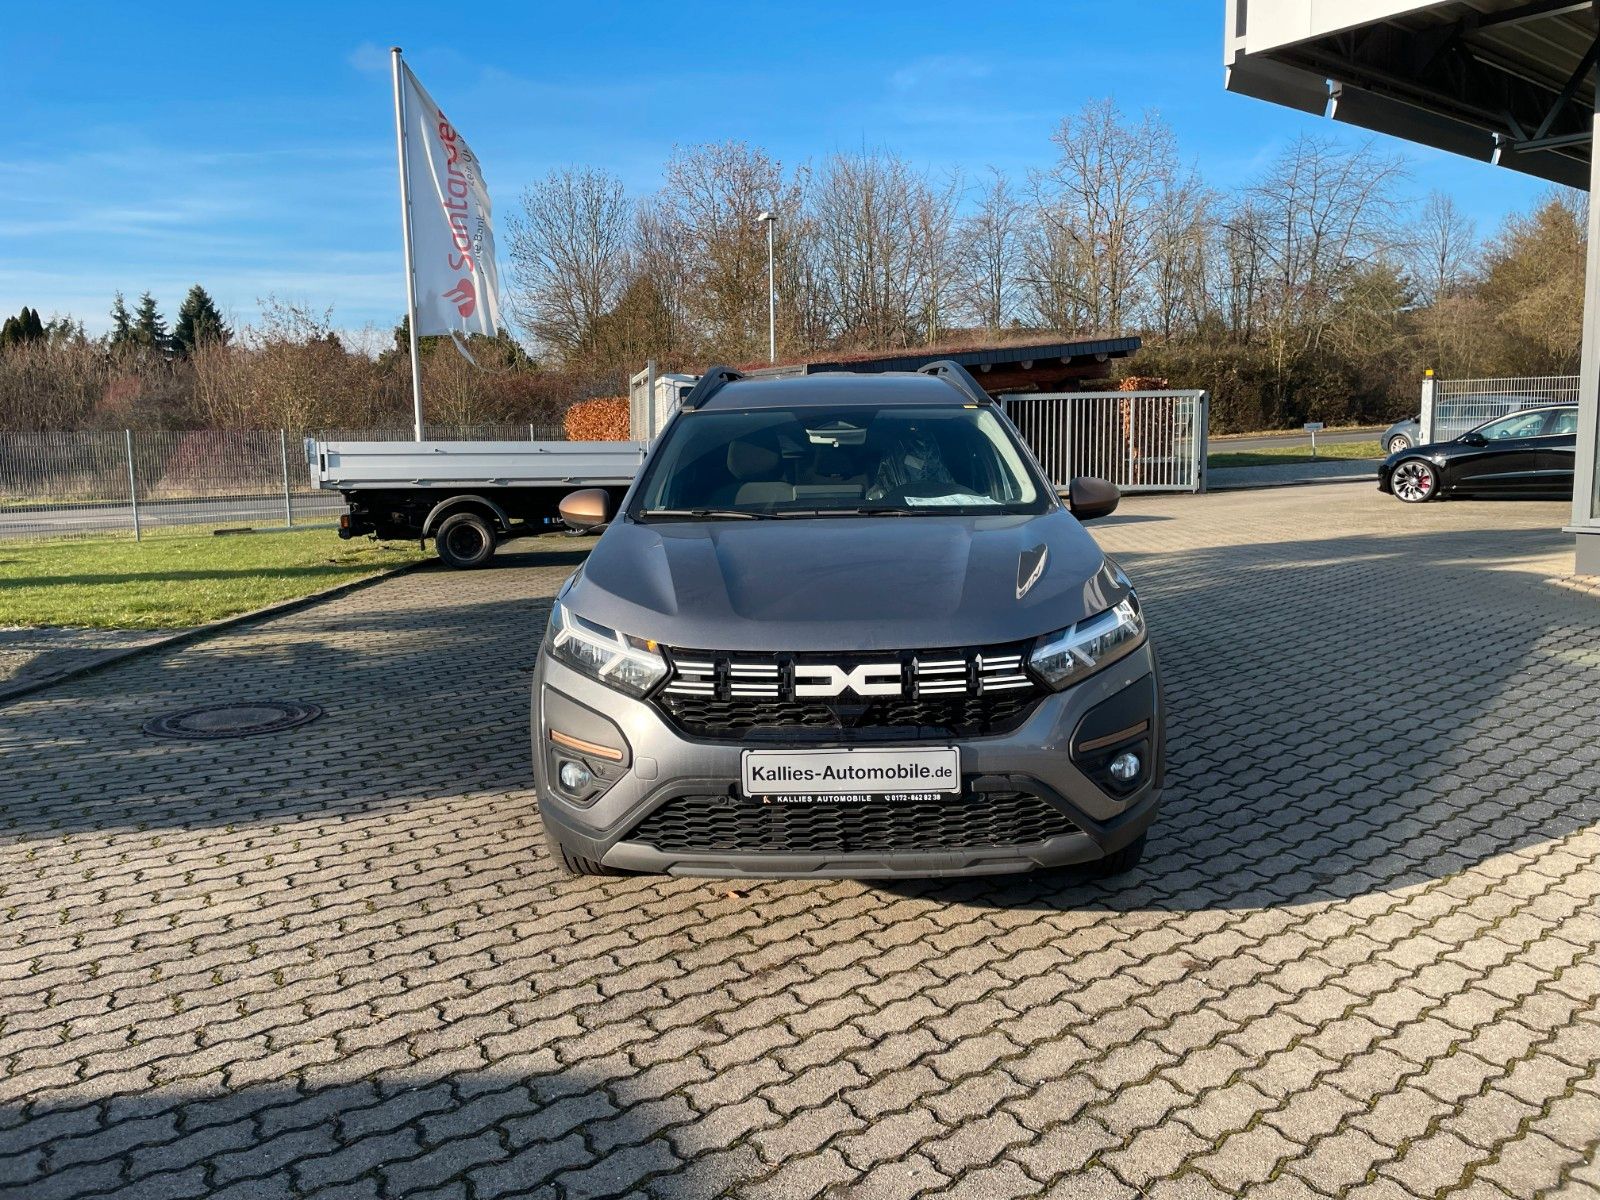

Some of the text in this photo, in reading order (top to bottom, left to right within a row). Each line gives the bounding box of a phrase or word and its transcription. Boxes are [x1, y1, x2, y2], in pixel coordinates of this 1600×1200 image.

[751, 763, 953, 781] Kallies-Automobile.de
[777, 795, 813, 803] KALLIES
[816, 794, 872, 803] AUTOMOBILE
